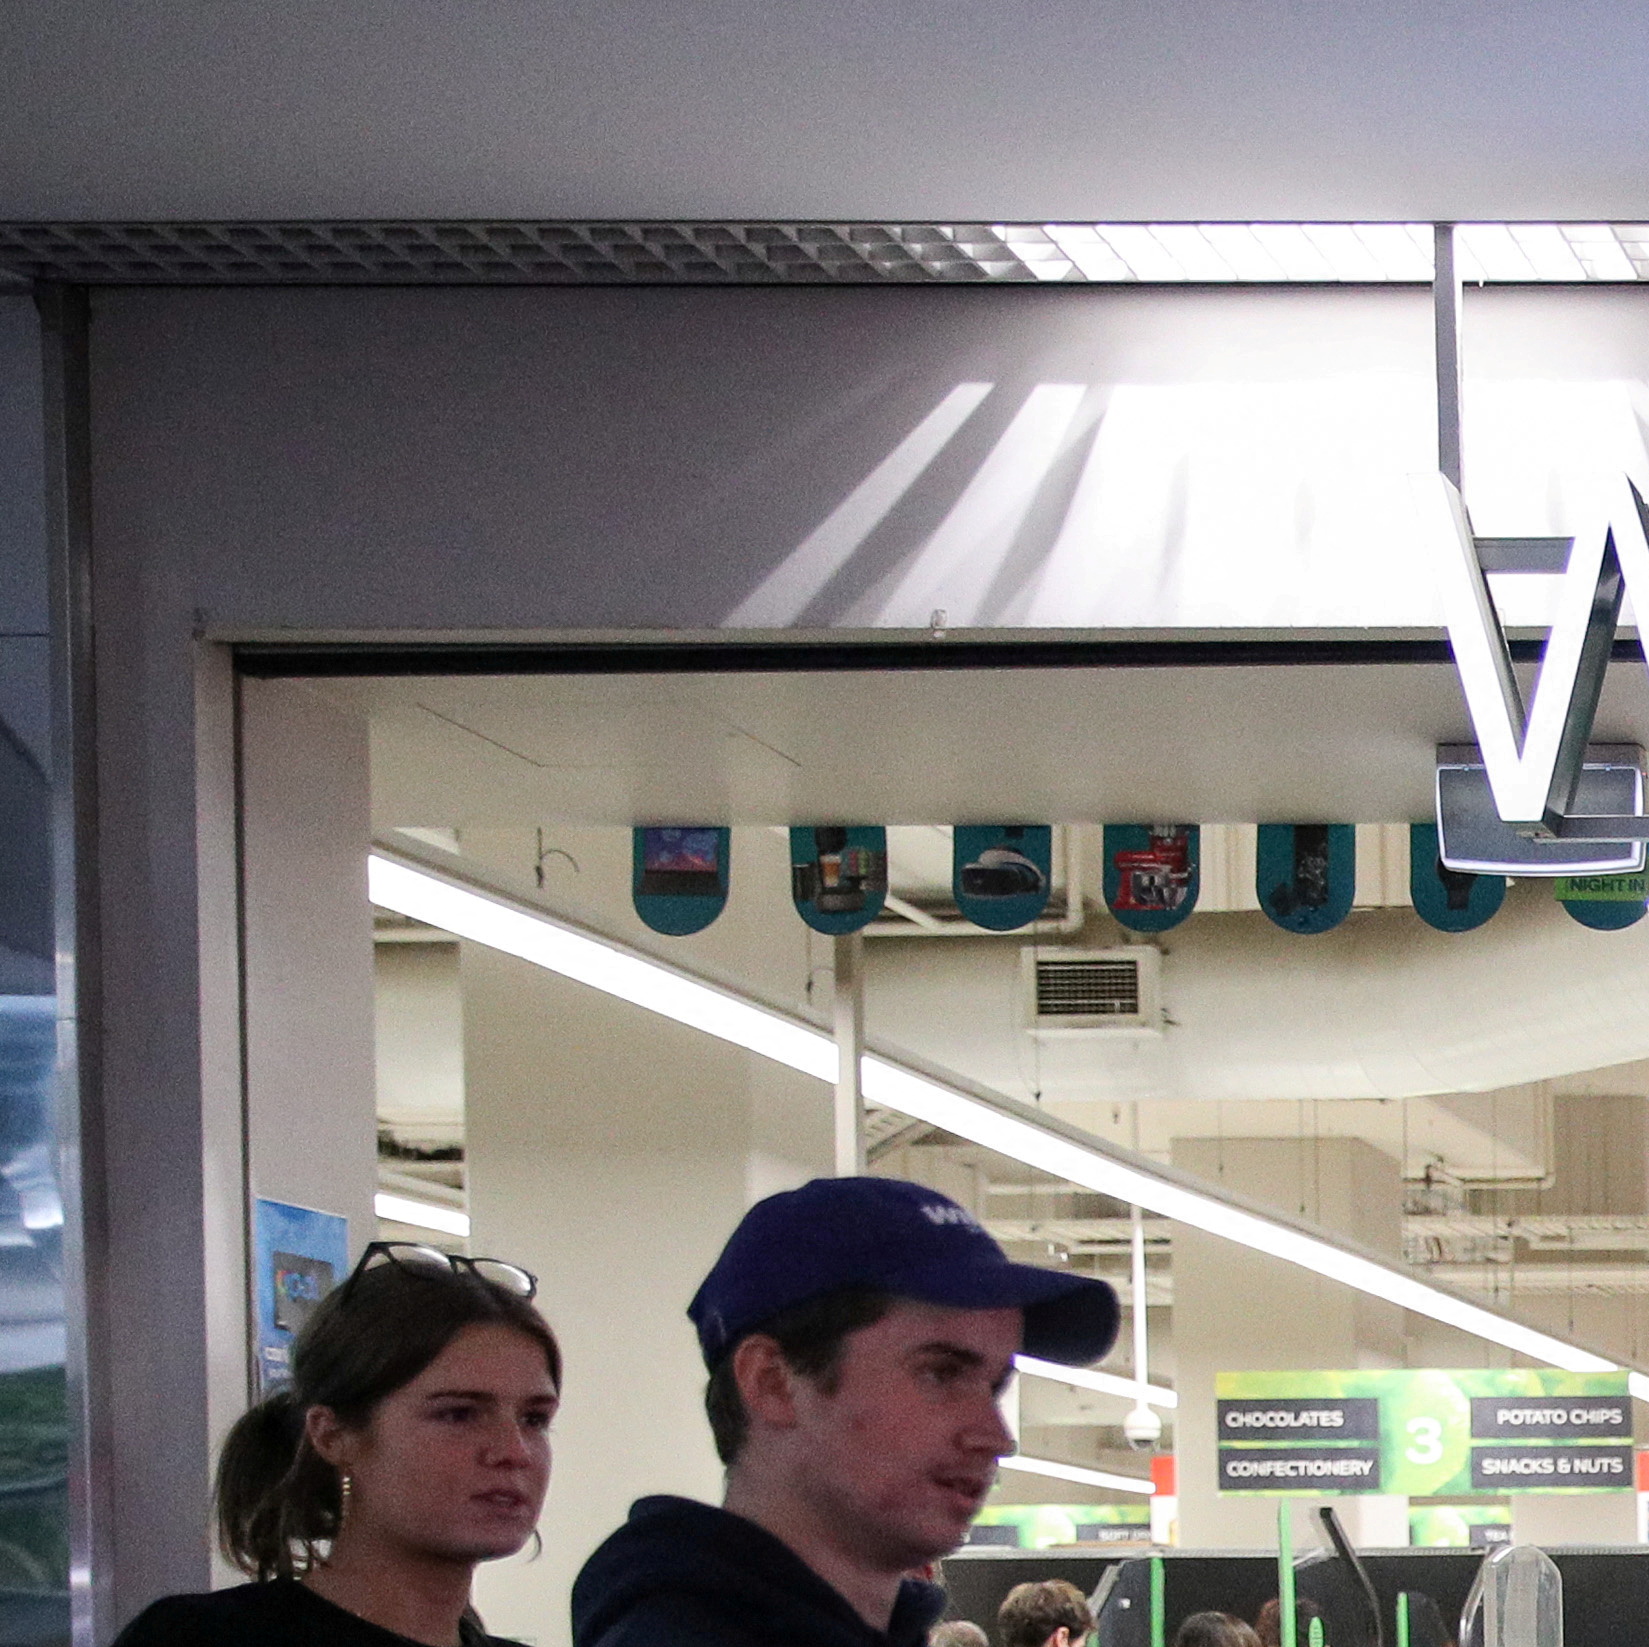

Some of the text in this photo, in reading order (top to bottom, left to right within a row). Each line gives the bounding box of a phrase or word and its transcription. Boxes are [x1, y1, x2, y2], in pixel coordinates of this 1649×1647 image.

[1570, 878, 1645, 892] NIGHT IN
[1225, 1410, 1344, 1428] CHOCOLATES
[1497, 1407, 1622, 1426] POTATO CHIPS
[1405, 1416, 1443, 1465] 3
[1226, 1459, 1375, 1478] CONFECTIONERY
[1481, 1456, 1623, 1475] SNACKS & NUTS
